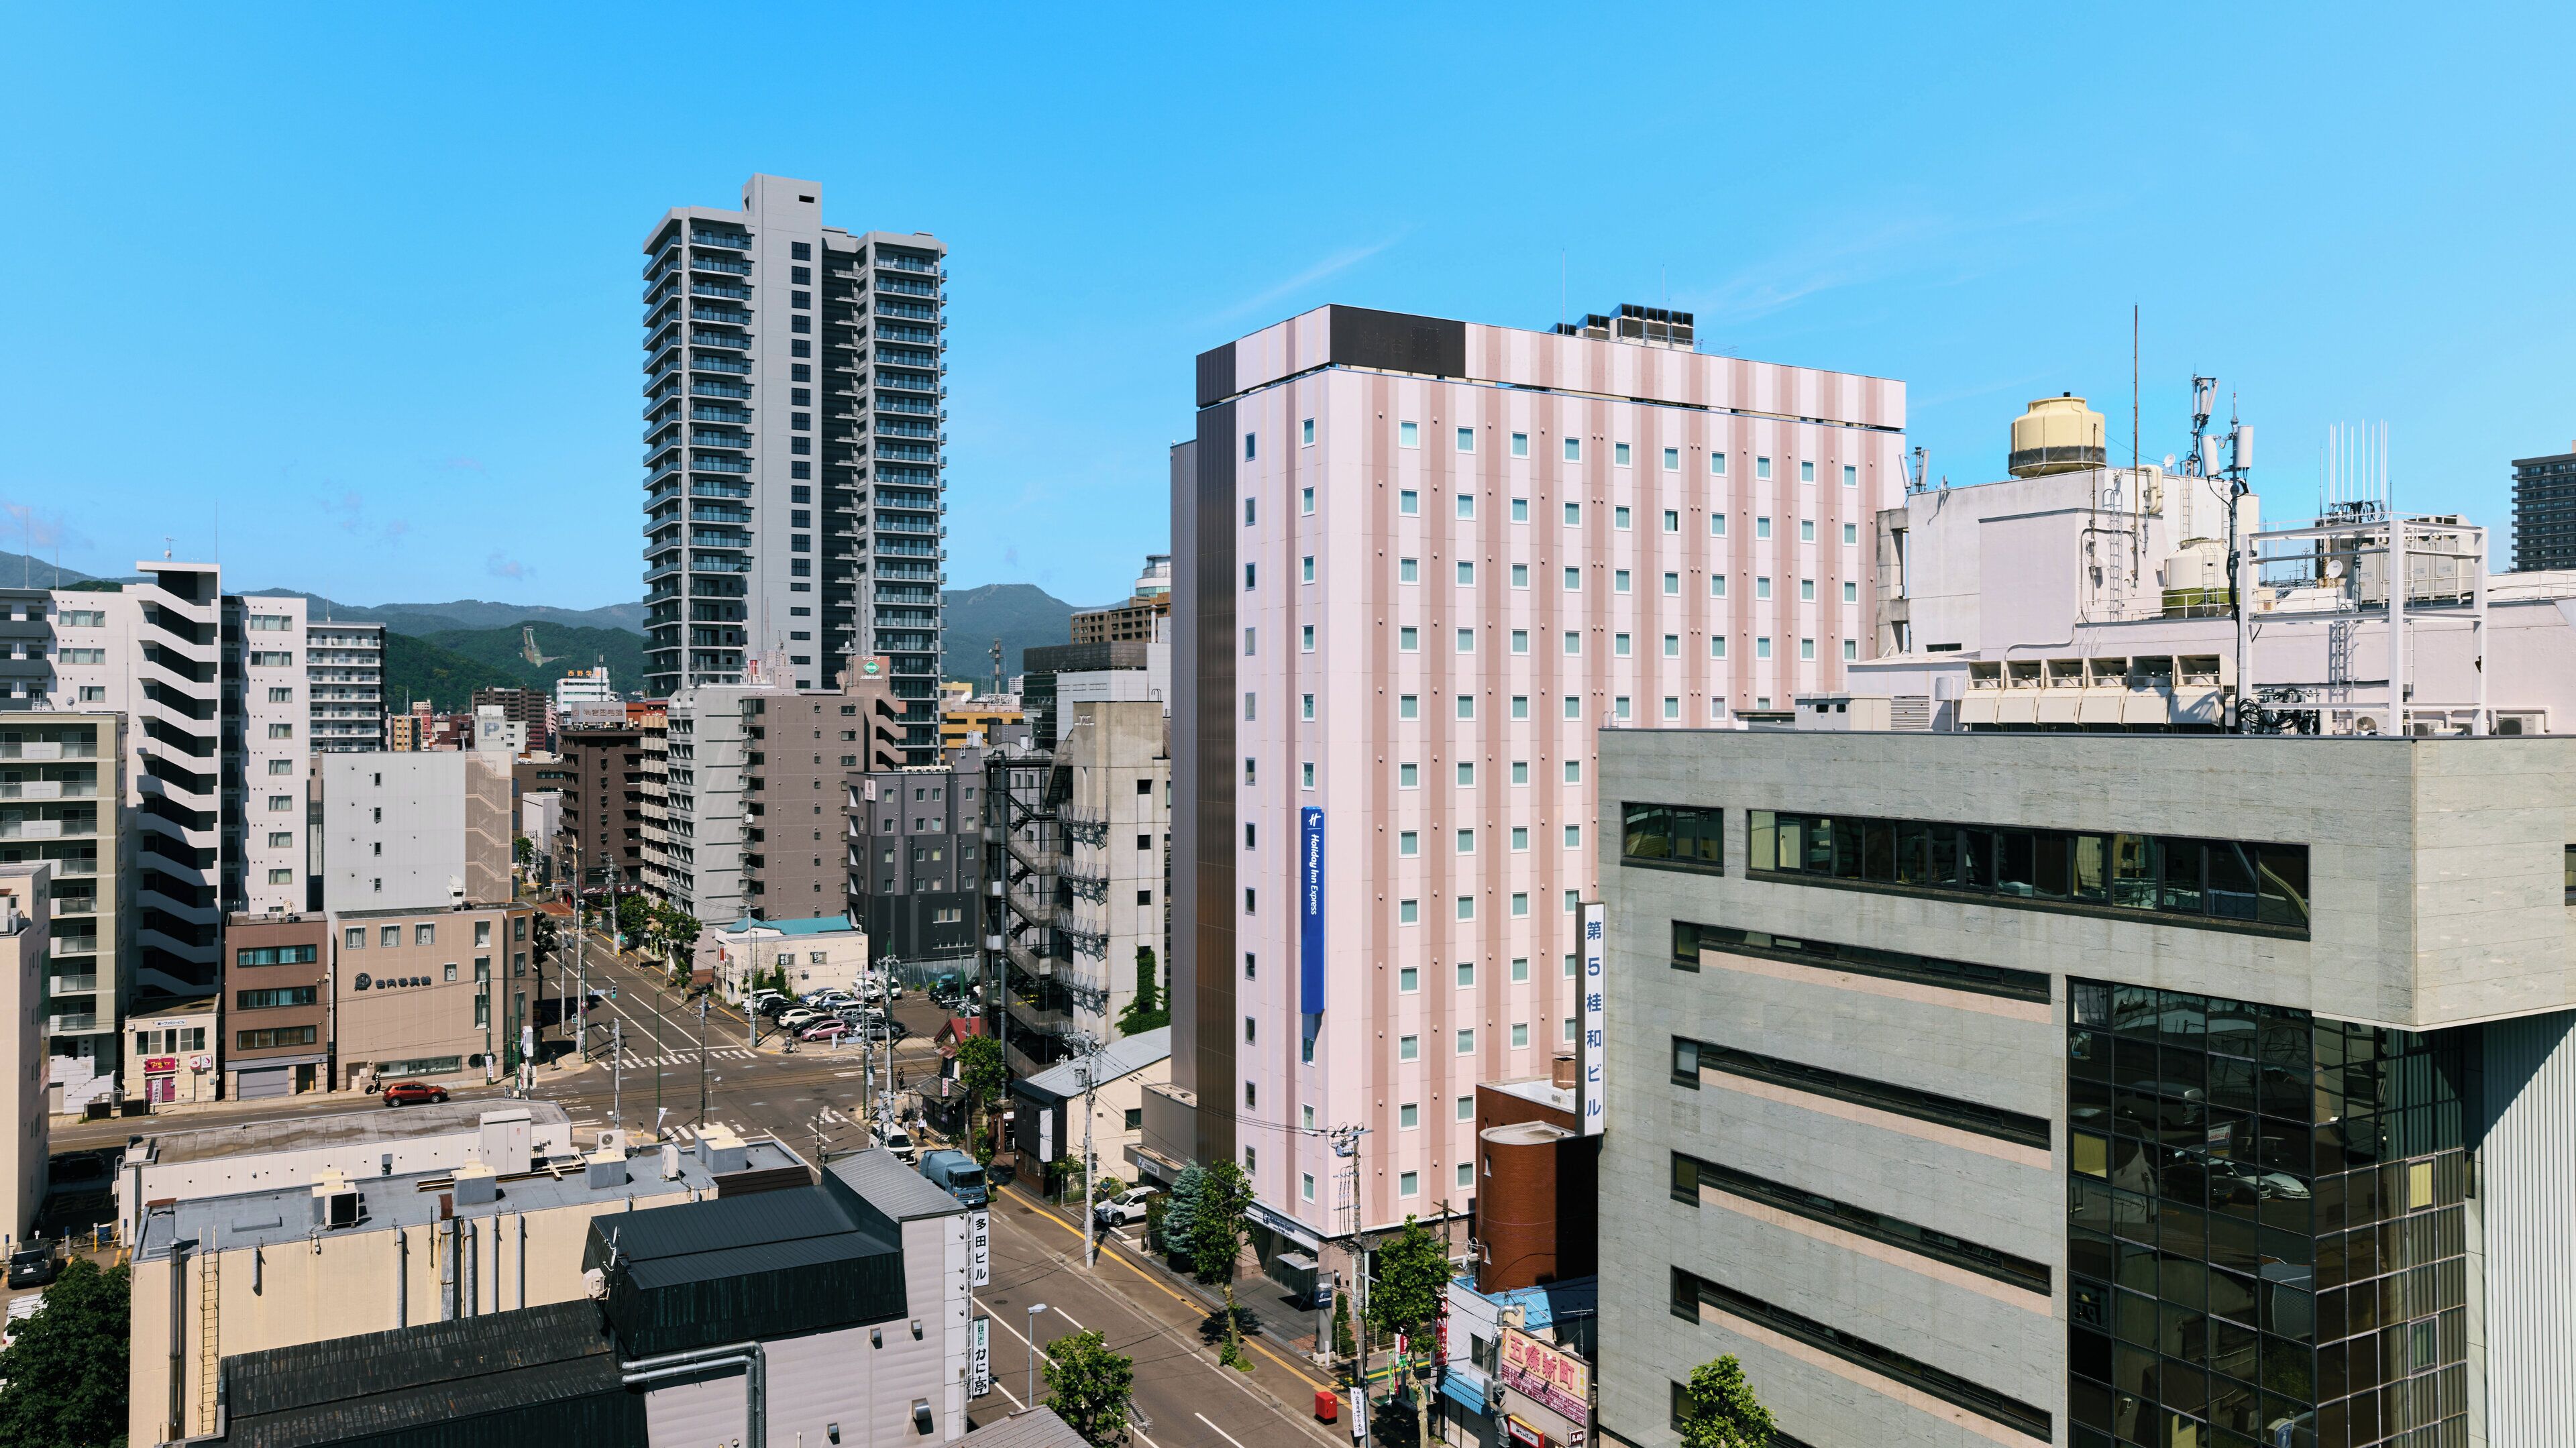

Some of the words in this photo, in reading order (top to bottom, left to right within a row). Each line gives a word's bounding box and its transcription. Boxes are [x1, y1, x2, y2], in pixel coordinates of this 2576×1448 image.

[1310, 834, 1320, 868] Holiday
[1311, 870, 1319, 883] Inn
[1309, 885, 1318, 915] Express
[1587, 922, 1602, 1118] 第5桂和ビル
[975, 1219, 986, 1280] 多田ビル
[975, 1348, 987, 1394] かに亭
